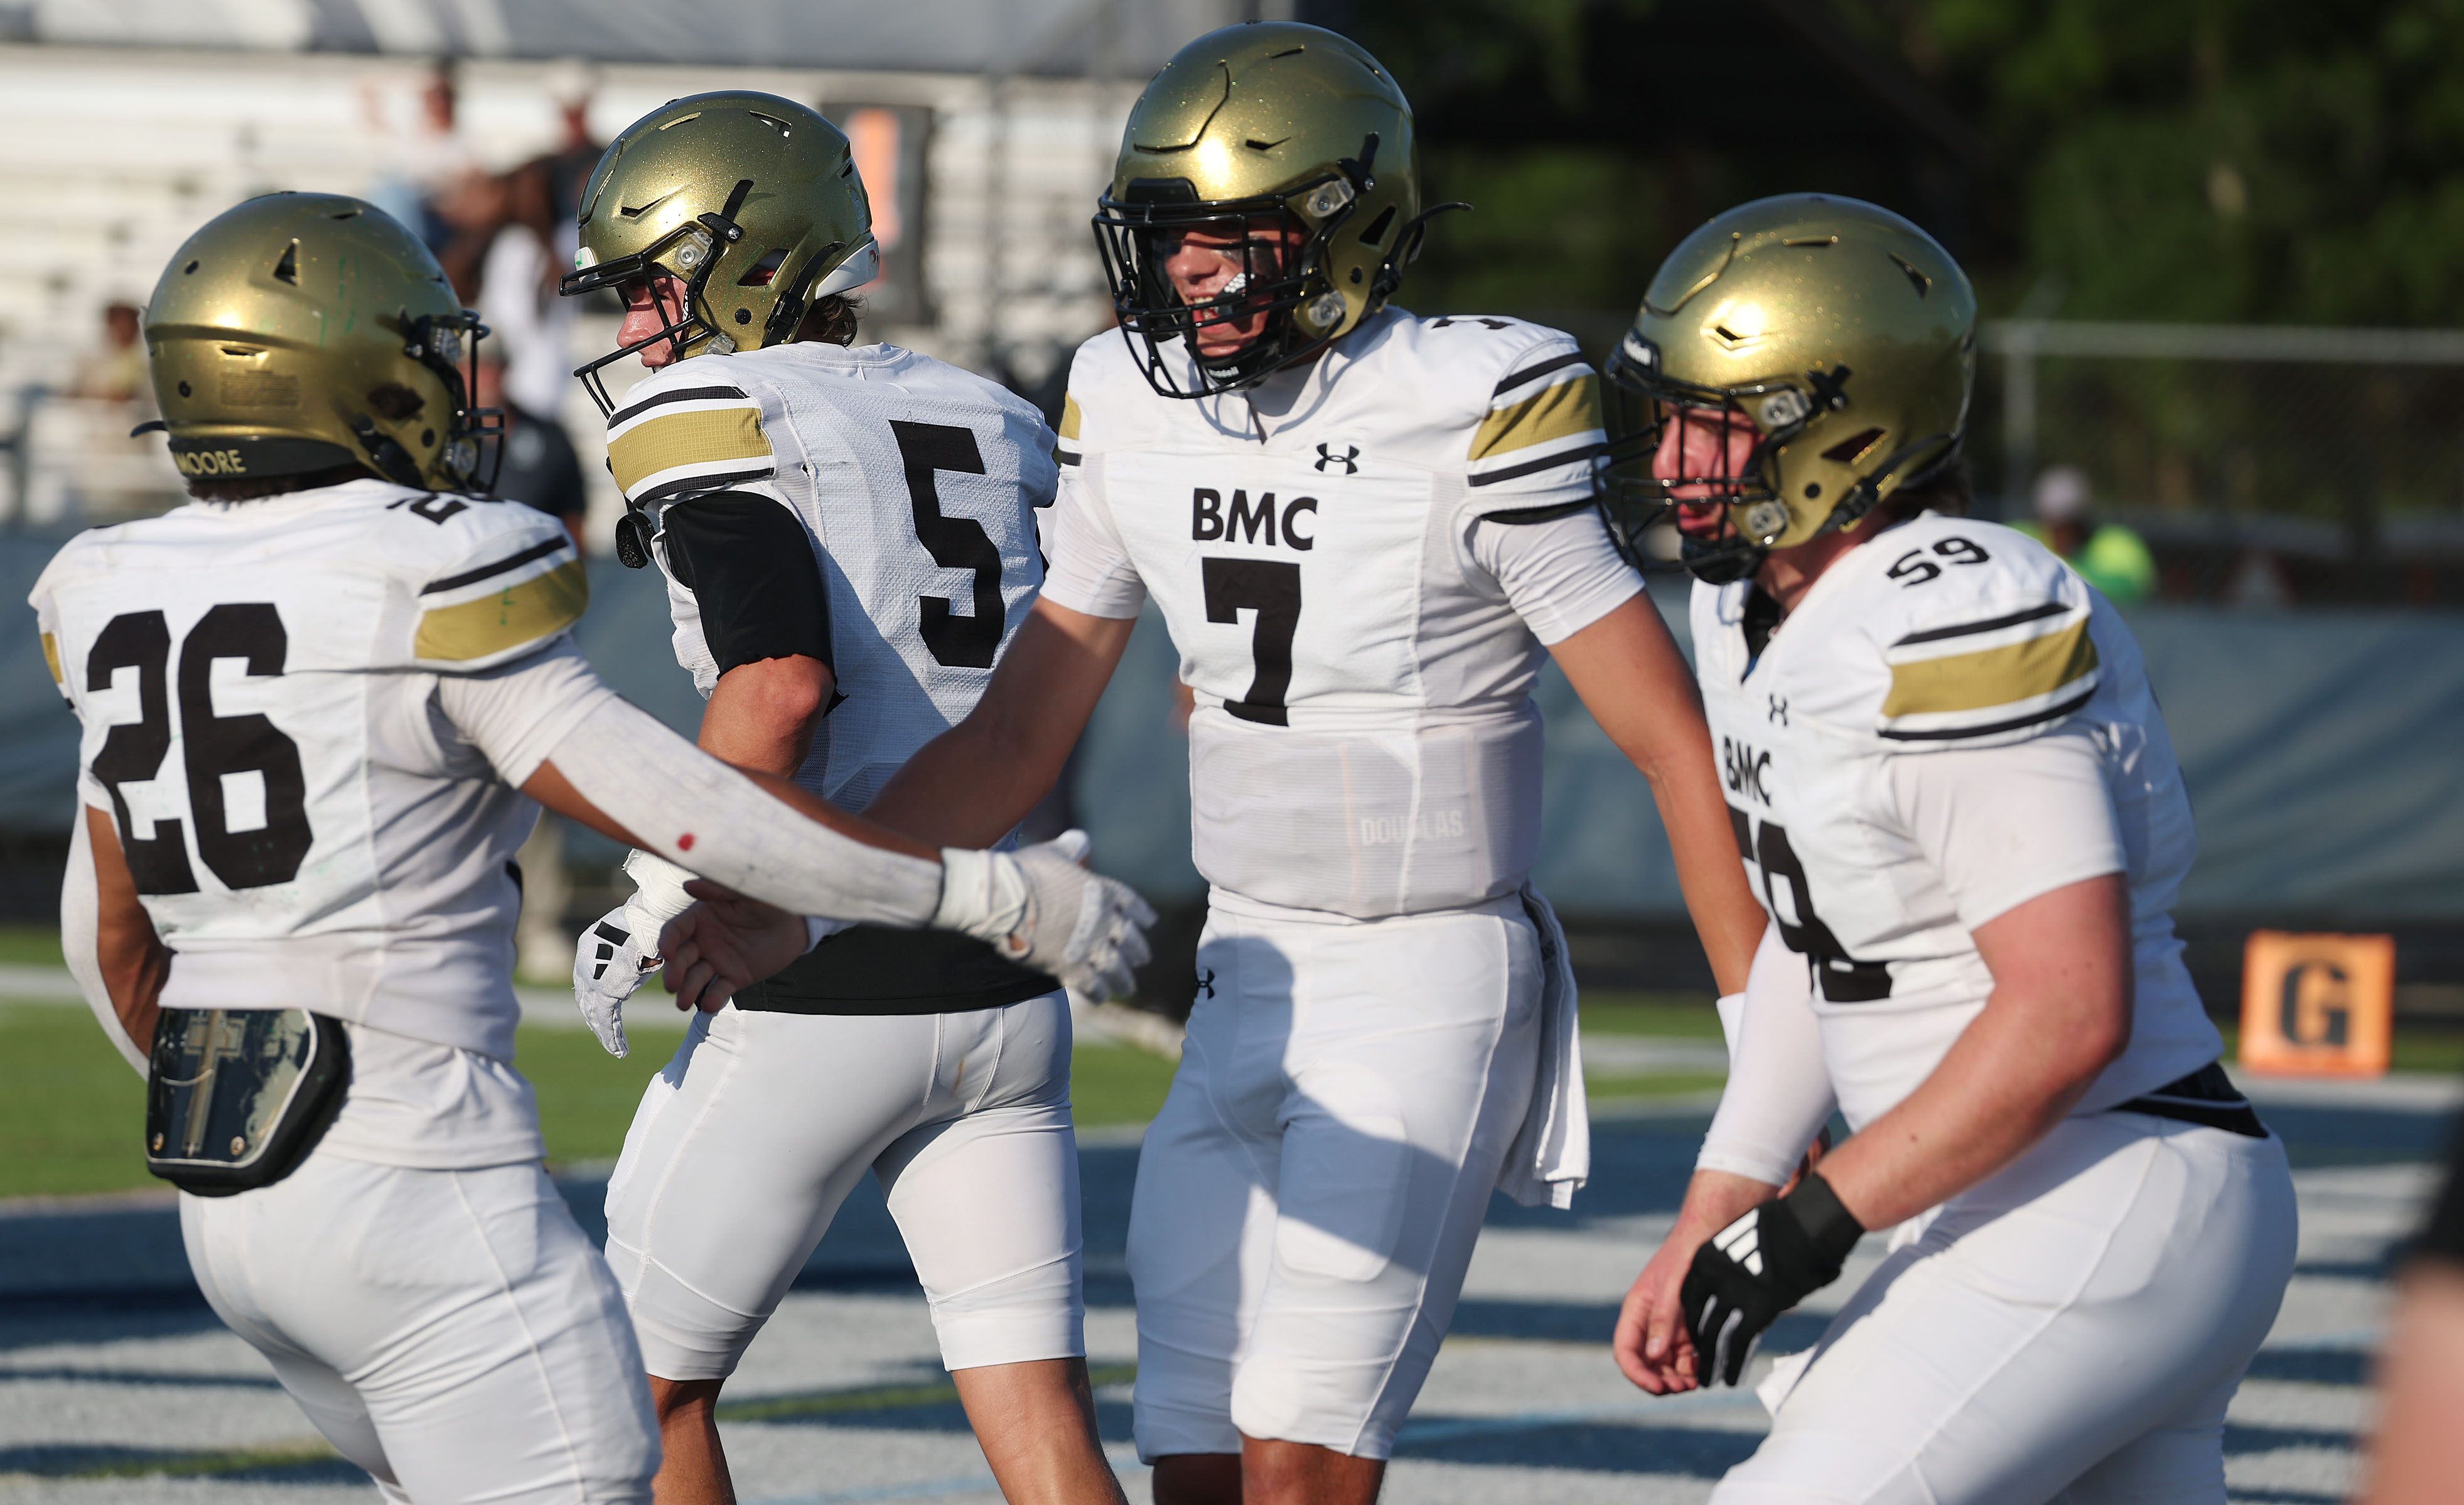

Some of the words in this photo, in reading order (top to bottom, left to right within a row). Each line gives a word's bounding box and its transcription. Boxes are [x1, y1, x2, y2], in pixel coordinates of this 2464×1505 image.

[171, 450, 247, 475] MOORE
[889, 420, 1005, 669] 5
[1193, 487, 1318, 551] BMC
[1886, 537, 1990, 588] 59
[1202, 556, 1301, 727] 7
[87, 602, 315, 895] 26
[1724, 735, 1771, 807] BMC
[2281, 961, 2349, 1047] G
